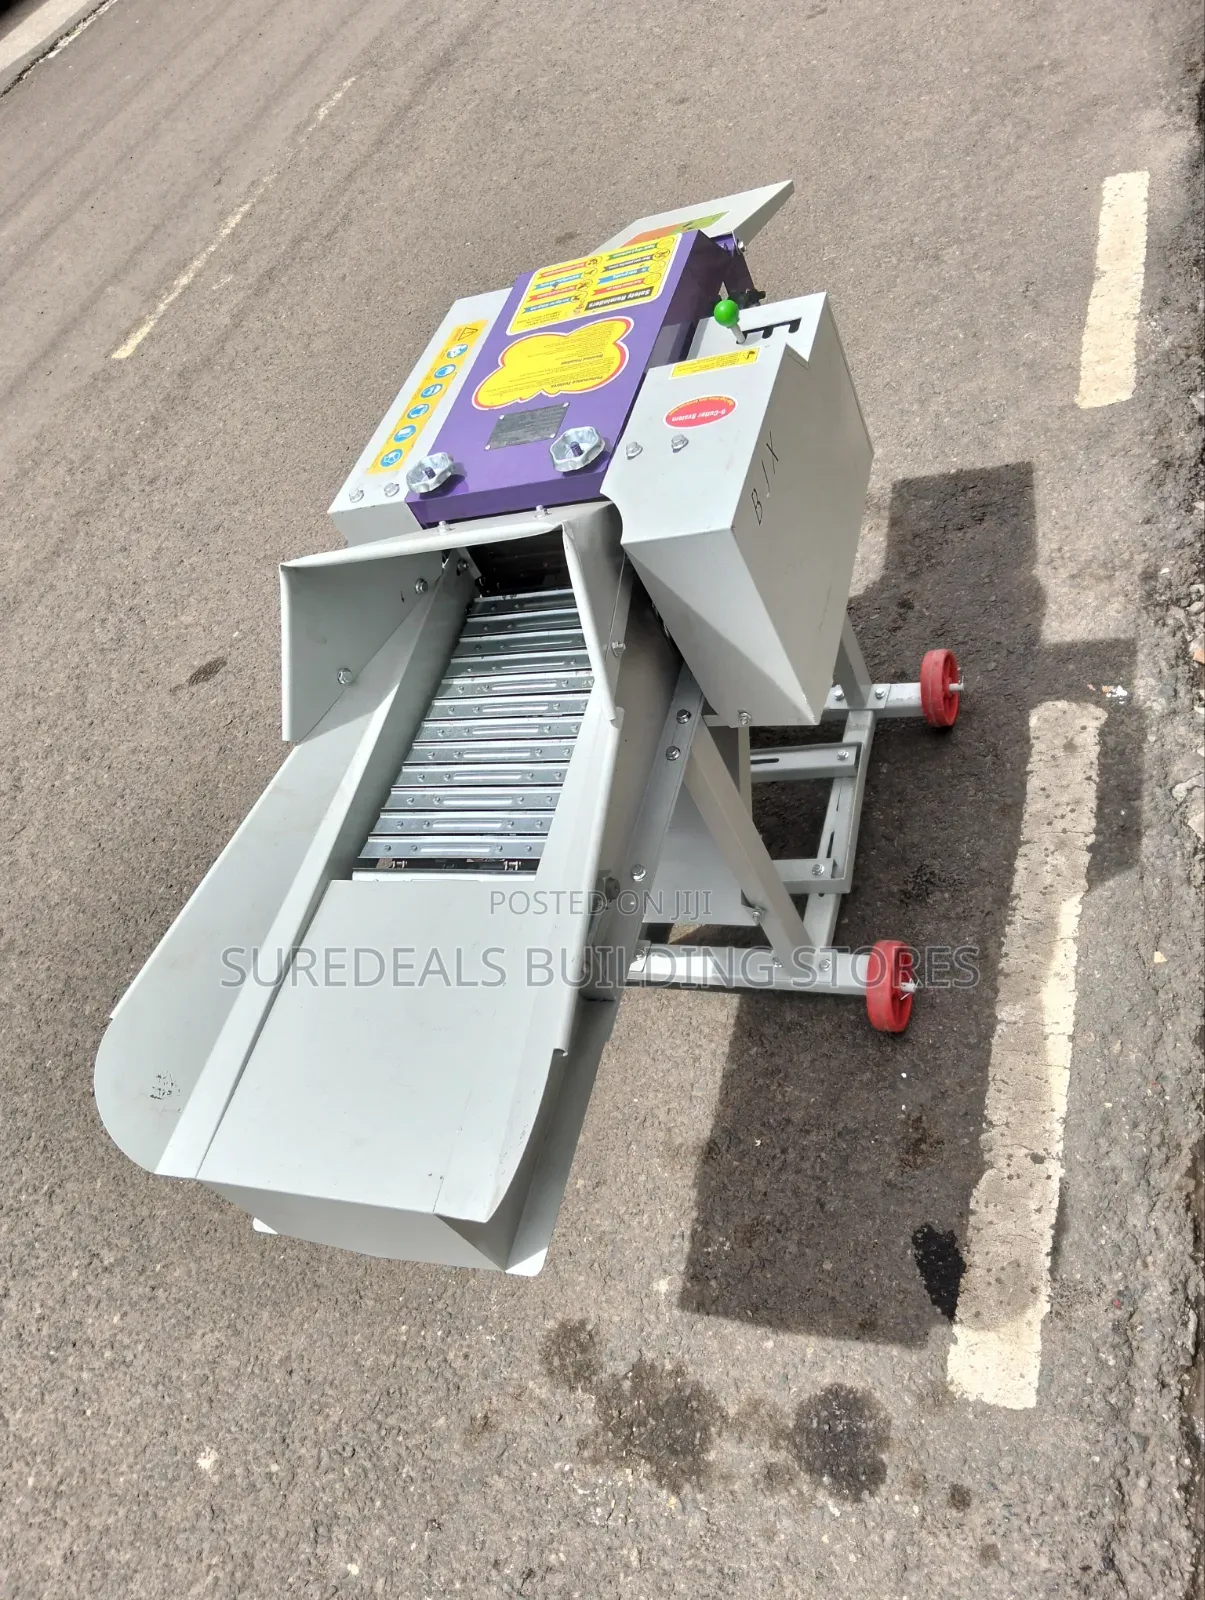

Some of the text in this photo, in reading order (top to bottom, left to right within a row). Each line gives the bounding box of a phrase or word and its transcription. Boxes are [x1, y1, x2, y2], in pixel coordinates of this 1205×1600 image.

[587, 288, 651, 309] Safety Reminders
[671, 412, 697, 422] System
